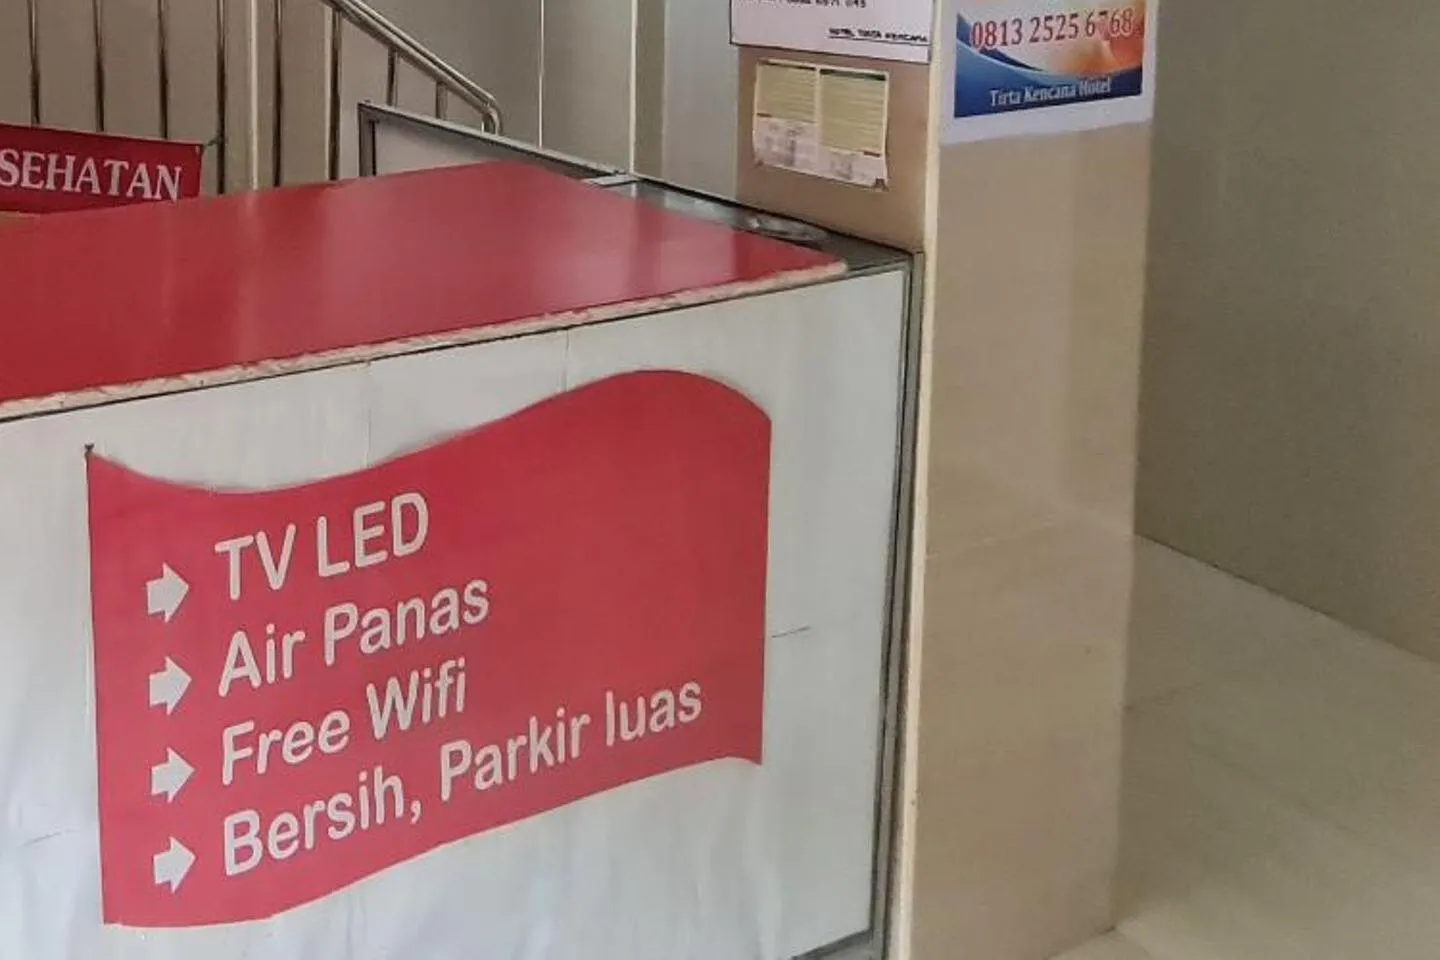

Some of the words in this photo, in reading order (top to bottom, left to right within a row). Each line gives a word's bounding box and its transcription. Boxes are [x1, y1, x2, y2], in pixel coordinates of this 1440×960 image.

[971, 18, 1023, 49] 0813
[1028, 12, 1080, 44] 2525
[990, 89, 1022, 107] Tirta
[1023, 85, 1078, 104] Kencana
[1078, 77, 1112, 97] Hotel
[214, 522, 297, 601] TV
[316, 491, 430, 578] LED
[217, 622, 307, 697] Air
[322, 577, 491, 667] Panas
[220, 709, 351, 786] Free
[366, 656, 467, 740] Wifi
[222, 765, 423, 877] Bersih,
[440, 707, 592, 801] Parkir
[605, 679, 704, 746] luas
